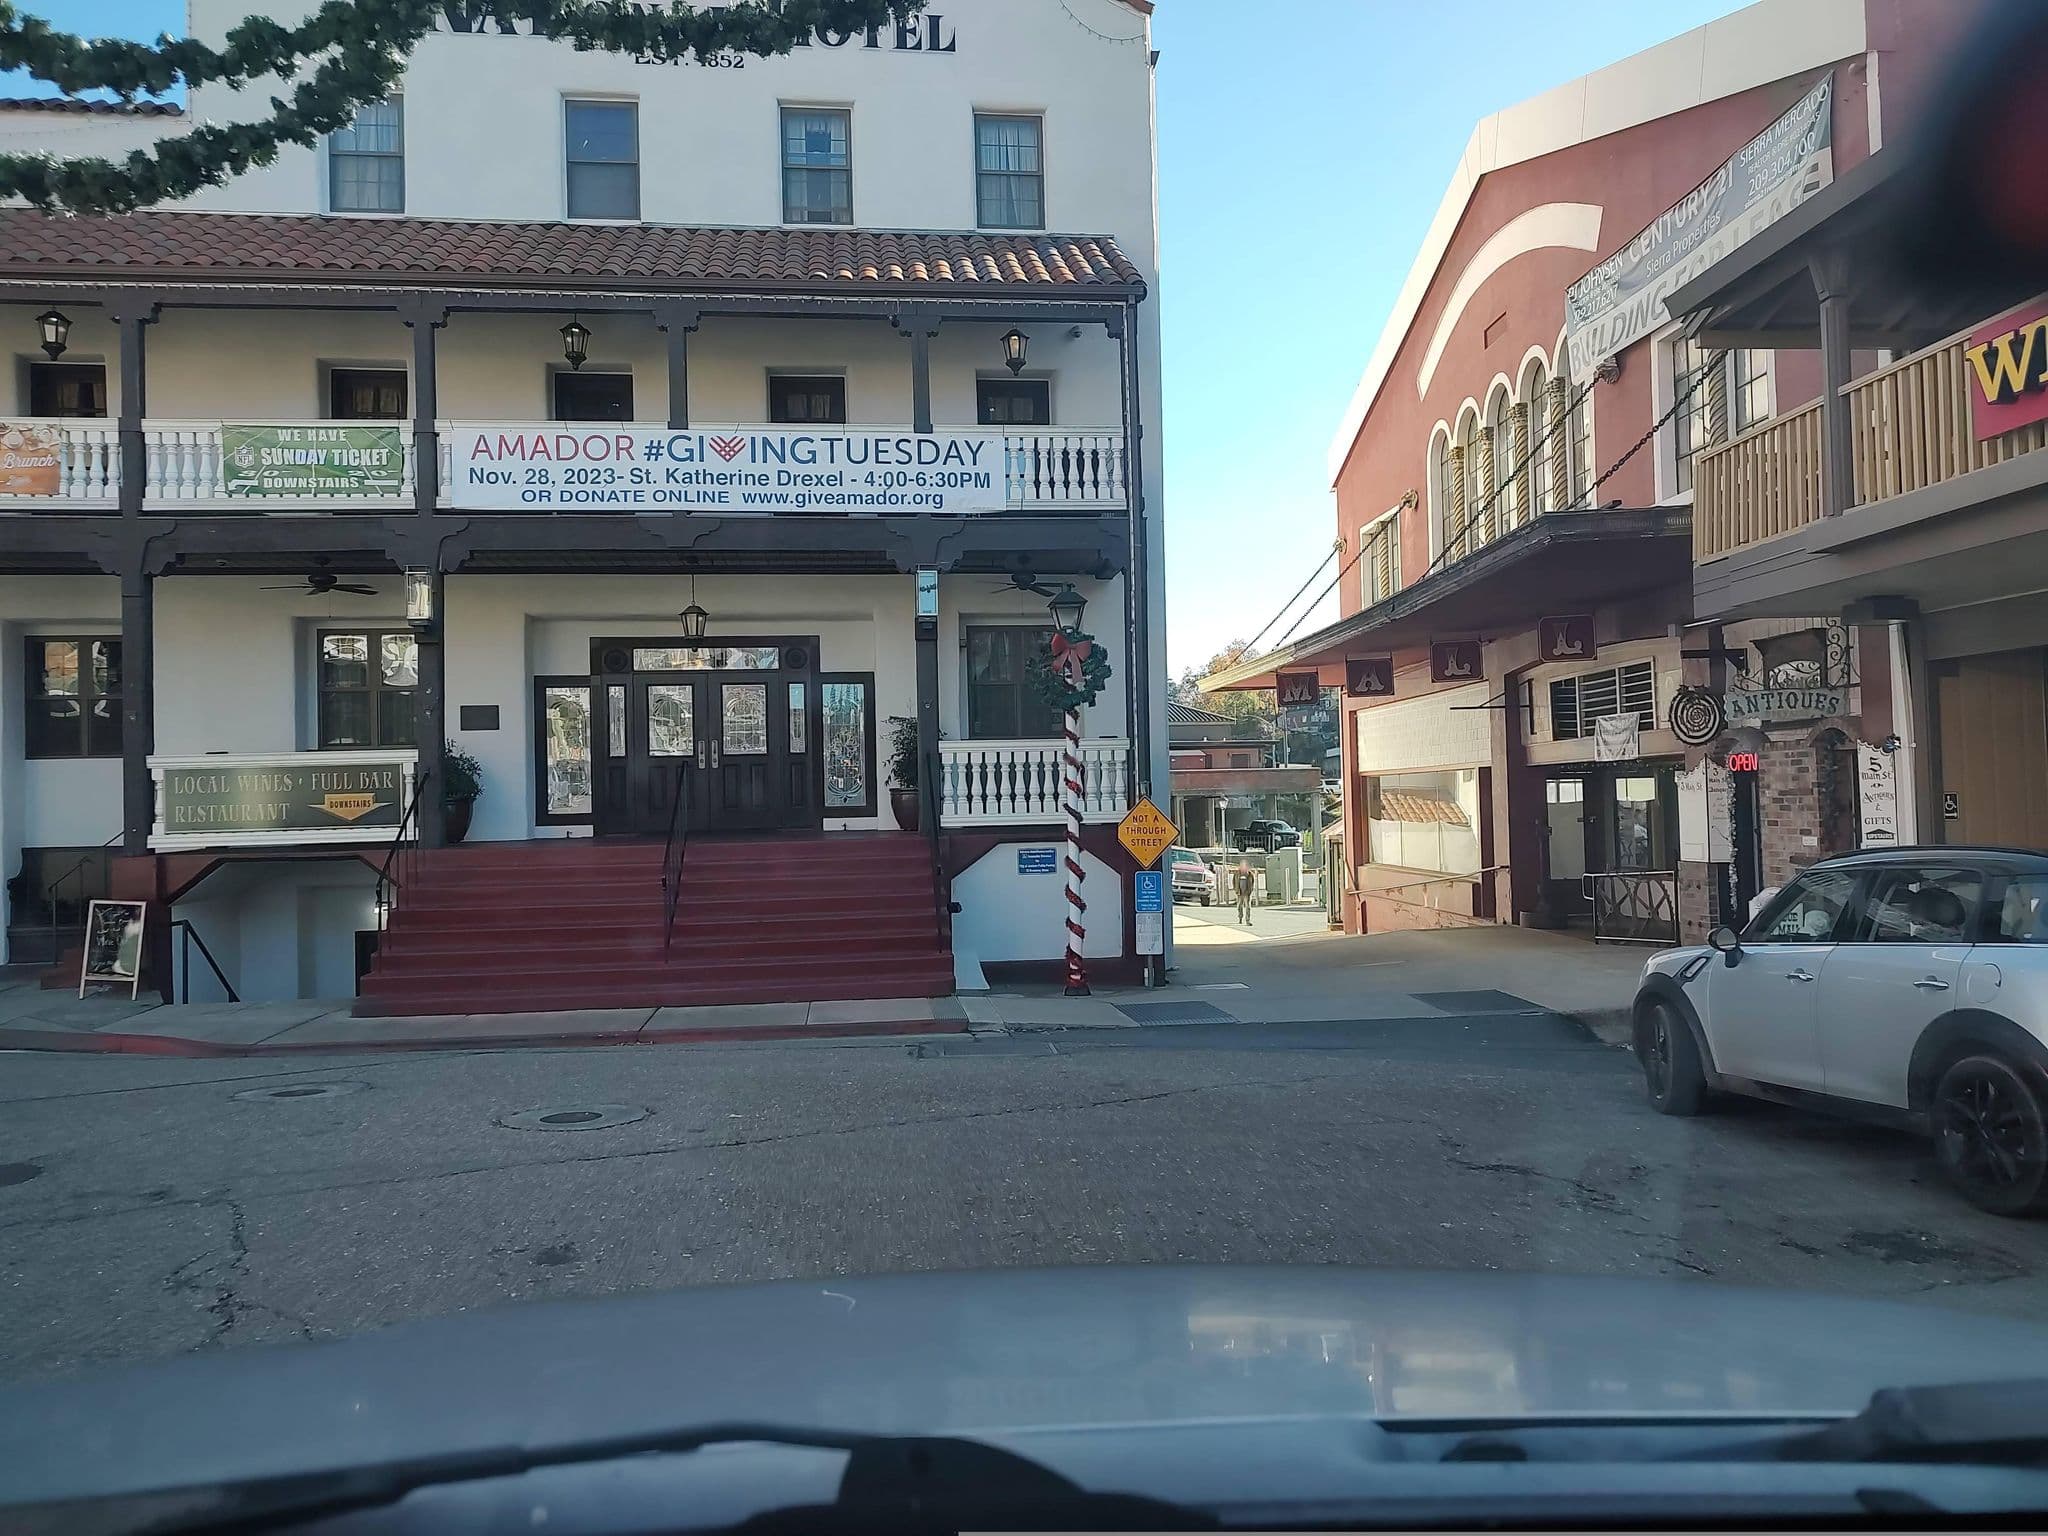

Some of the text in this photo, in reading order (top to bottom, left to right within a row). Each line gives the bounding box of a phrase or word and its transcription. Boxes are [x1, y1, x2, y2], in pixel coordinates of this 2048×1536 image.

[1740, 131, 1773, 168] SIERRA
[1774, 83, 1829, 140] MERCADO
[1629, 180, 1711, 264] CENTURY
[1715, 160, 1733, 198] 21
[1646, 210, 1721, 279] Sierra Properties
[1569, 280, 1667, 377] BUILDING
[277, 429, 348, 441] WE HAVE
[260, 447, 328, 466] SUNDAY
[331, 448, 390, 466] TICKET
[470, 434, 636, 462] AMADOR
[4, 452, 56, 470] Brunch
[263, 477, 360, 489] DOWNSTAIRS
[469, 467, 517, 485] Nov.
[524, 468, 556, 487] 28,
[630, 467, 658, 485] St.
[665, 467, 770, 487] Katherine
[777, 470, 844, 488] Drexel
[863, 470, 991, 489] 4:00-6:30PM
[521, 489, 945, 509] OR DONATE ONLINE www.giveamador.org
[1732, 691, 1841, 718] ANTIQUES
[1729, 753, 1759, 772] OPEN
[1868, 756, 1883, 773] 5
[174, 771, 394, 795] LOCAL WINES FULL BAR
[1861, 772, 1881, 780] Main
[175, 799, 372, 824] RESTAURANT DOWNSTAIRS
[1132, 814, 1159, 824] NOT A
[1864, 816, 1892, 825] GIFTS
[1125, 826, 1167, 835] THROUGH
[1130, 838, 1163, 847] STREET
